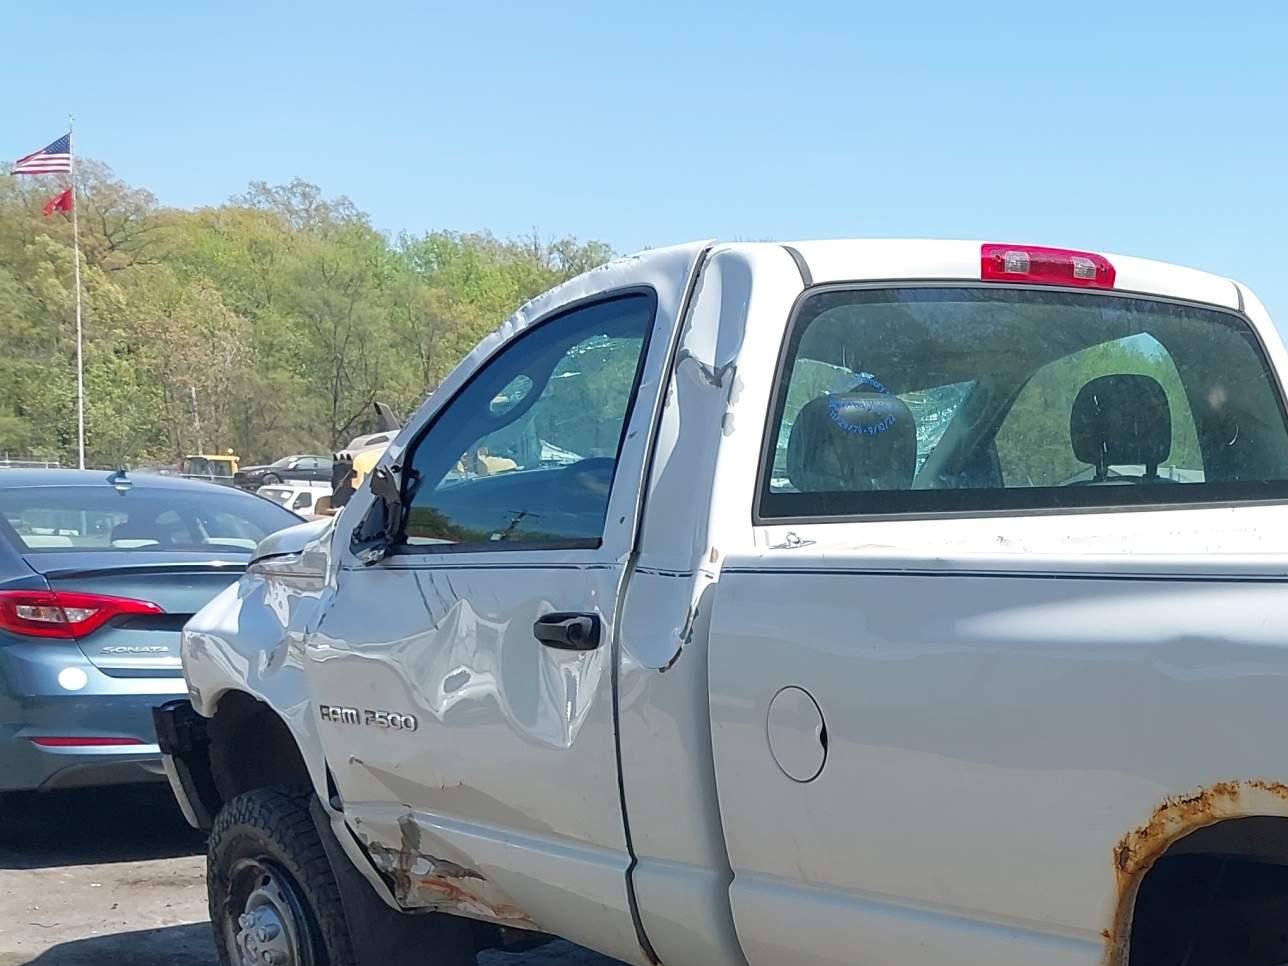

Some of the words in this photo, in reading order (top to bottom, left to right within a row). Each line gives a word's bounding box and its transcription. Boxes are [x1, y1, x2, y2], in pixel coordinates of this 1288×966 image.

[100, 646, 168, 655] SONATA
[320, 704, 361, 726] RAM
[364, 709, 418, 732] 2500
